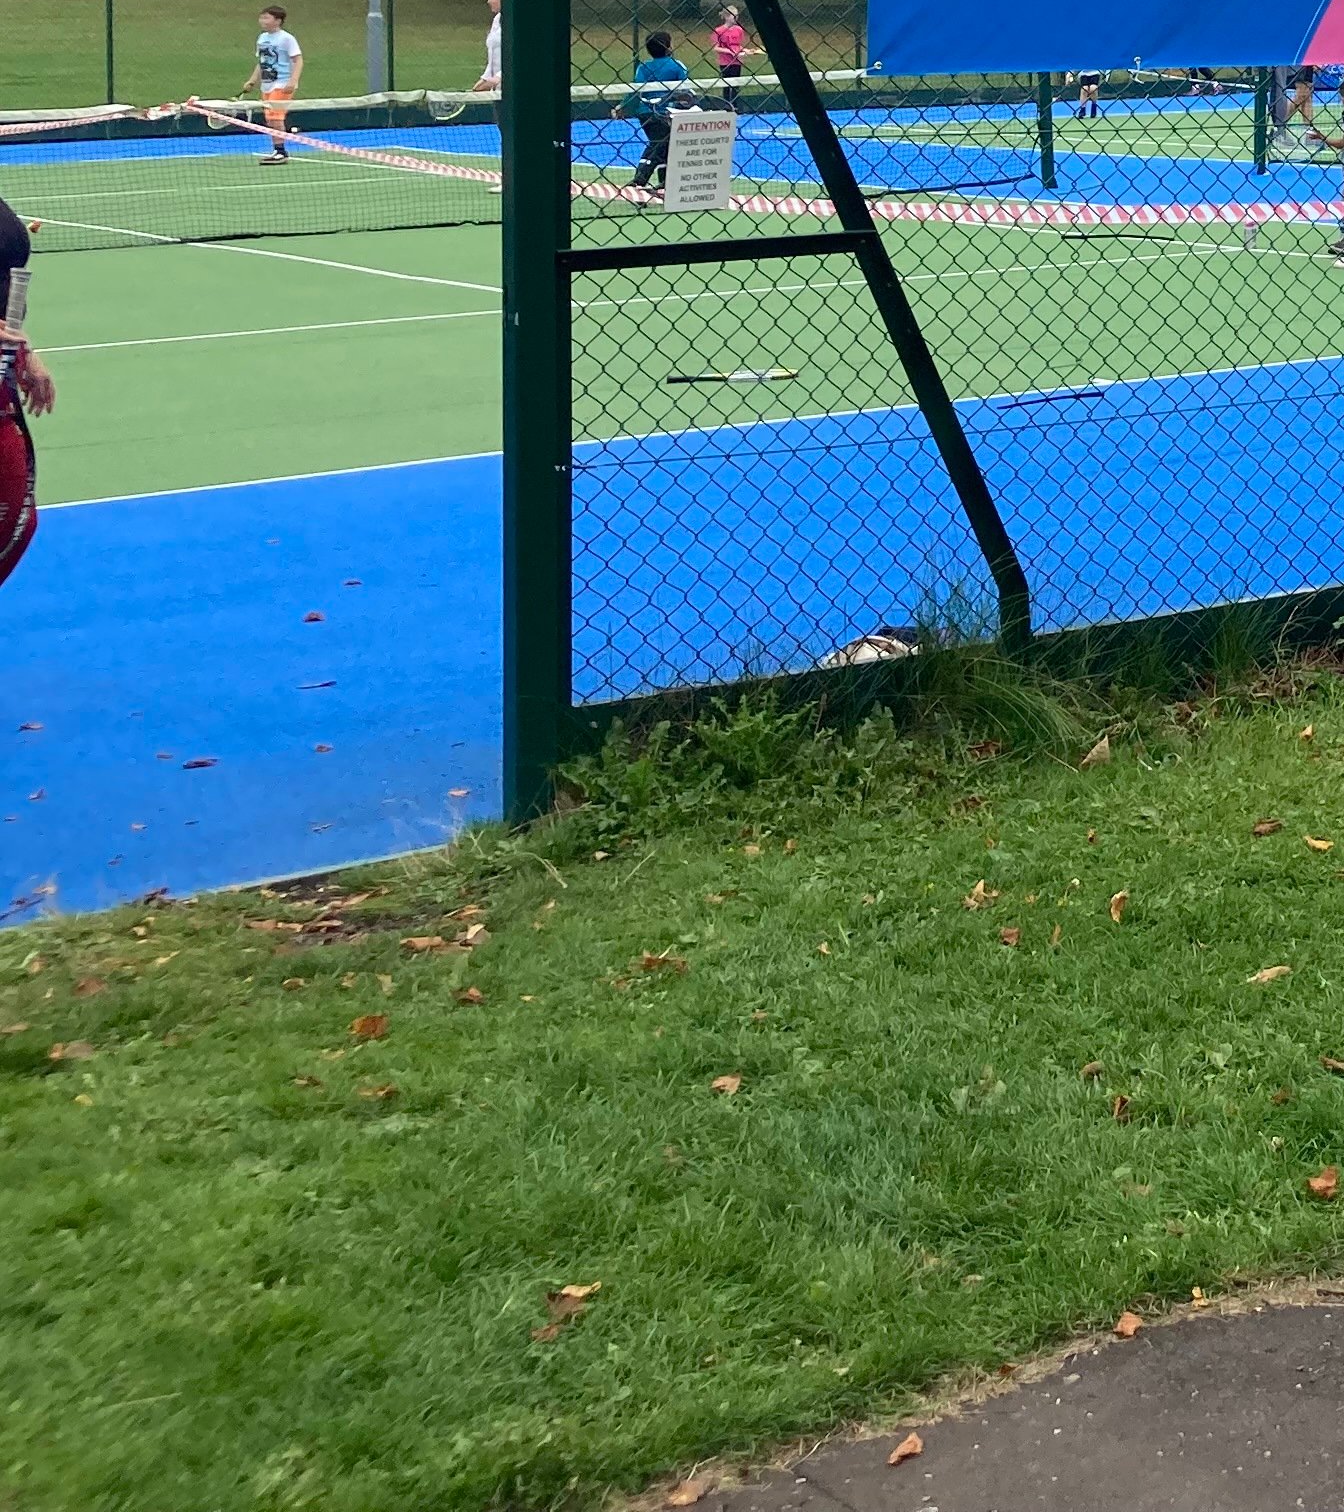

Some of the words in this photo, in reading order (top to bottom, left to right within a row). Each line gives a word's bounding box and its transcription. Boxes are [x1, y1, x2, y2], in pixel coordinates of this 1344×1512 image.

[677, 120, 731, 133] ATTENTION
[676, 138, 699, 146] THESE
[700, 136, 730, 145] COURTS
[677, 159, 703, 168] TENNIS
[704, 158, 723, 166] ONLY
[693, 172, 718, 180] OTHER
[679, 183, 717, 192] ACTIVITIES
[680, 193, 716, 203] ALLOWED
